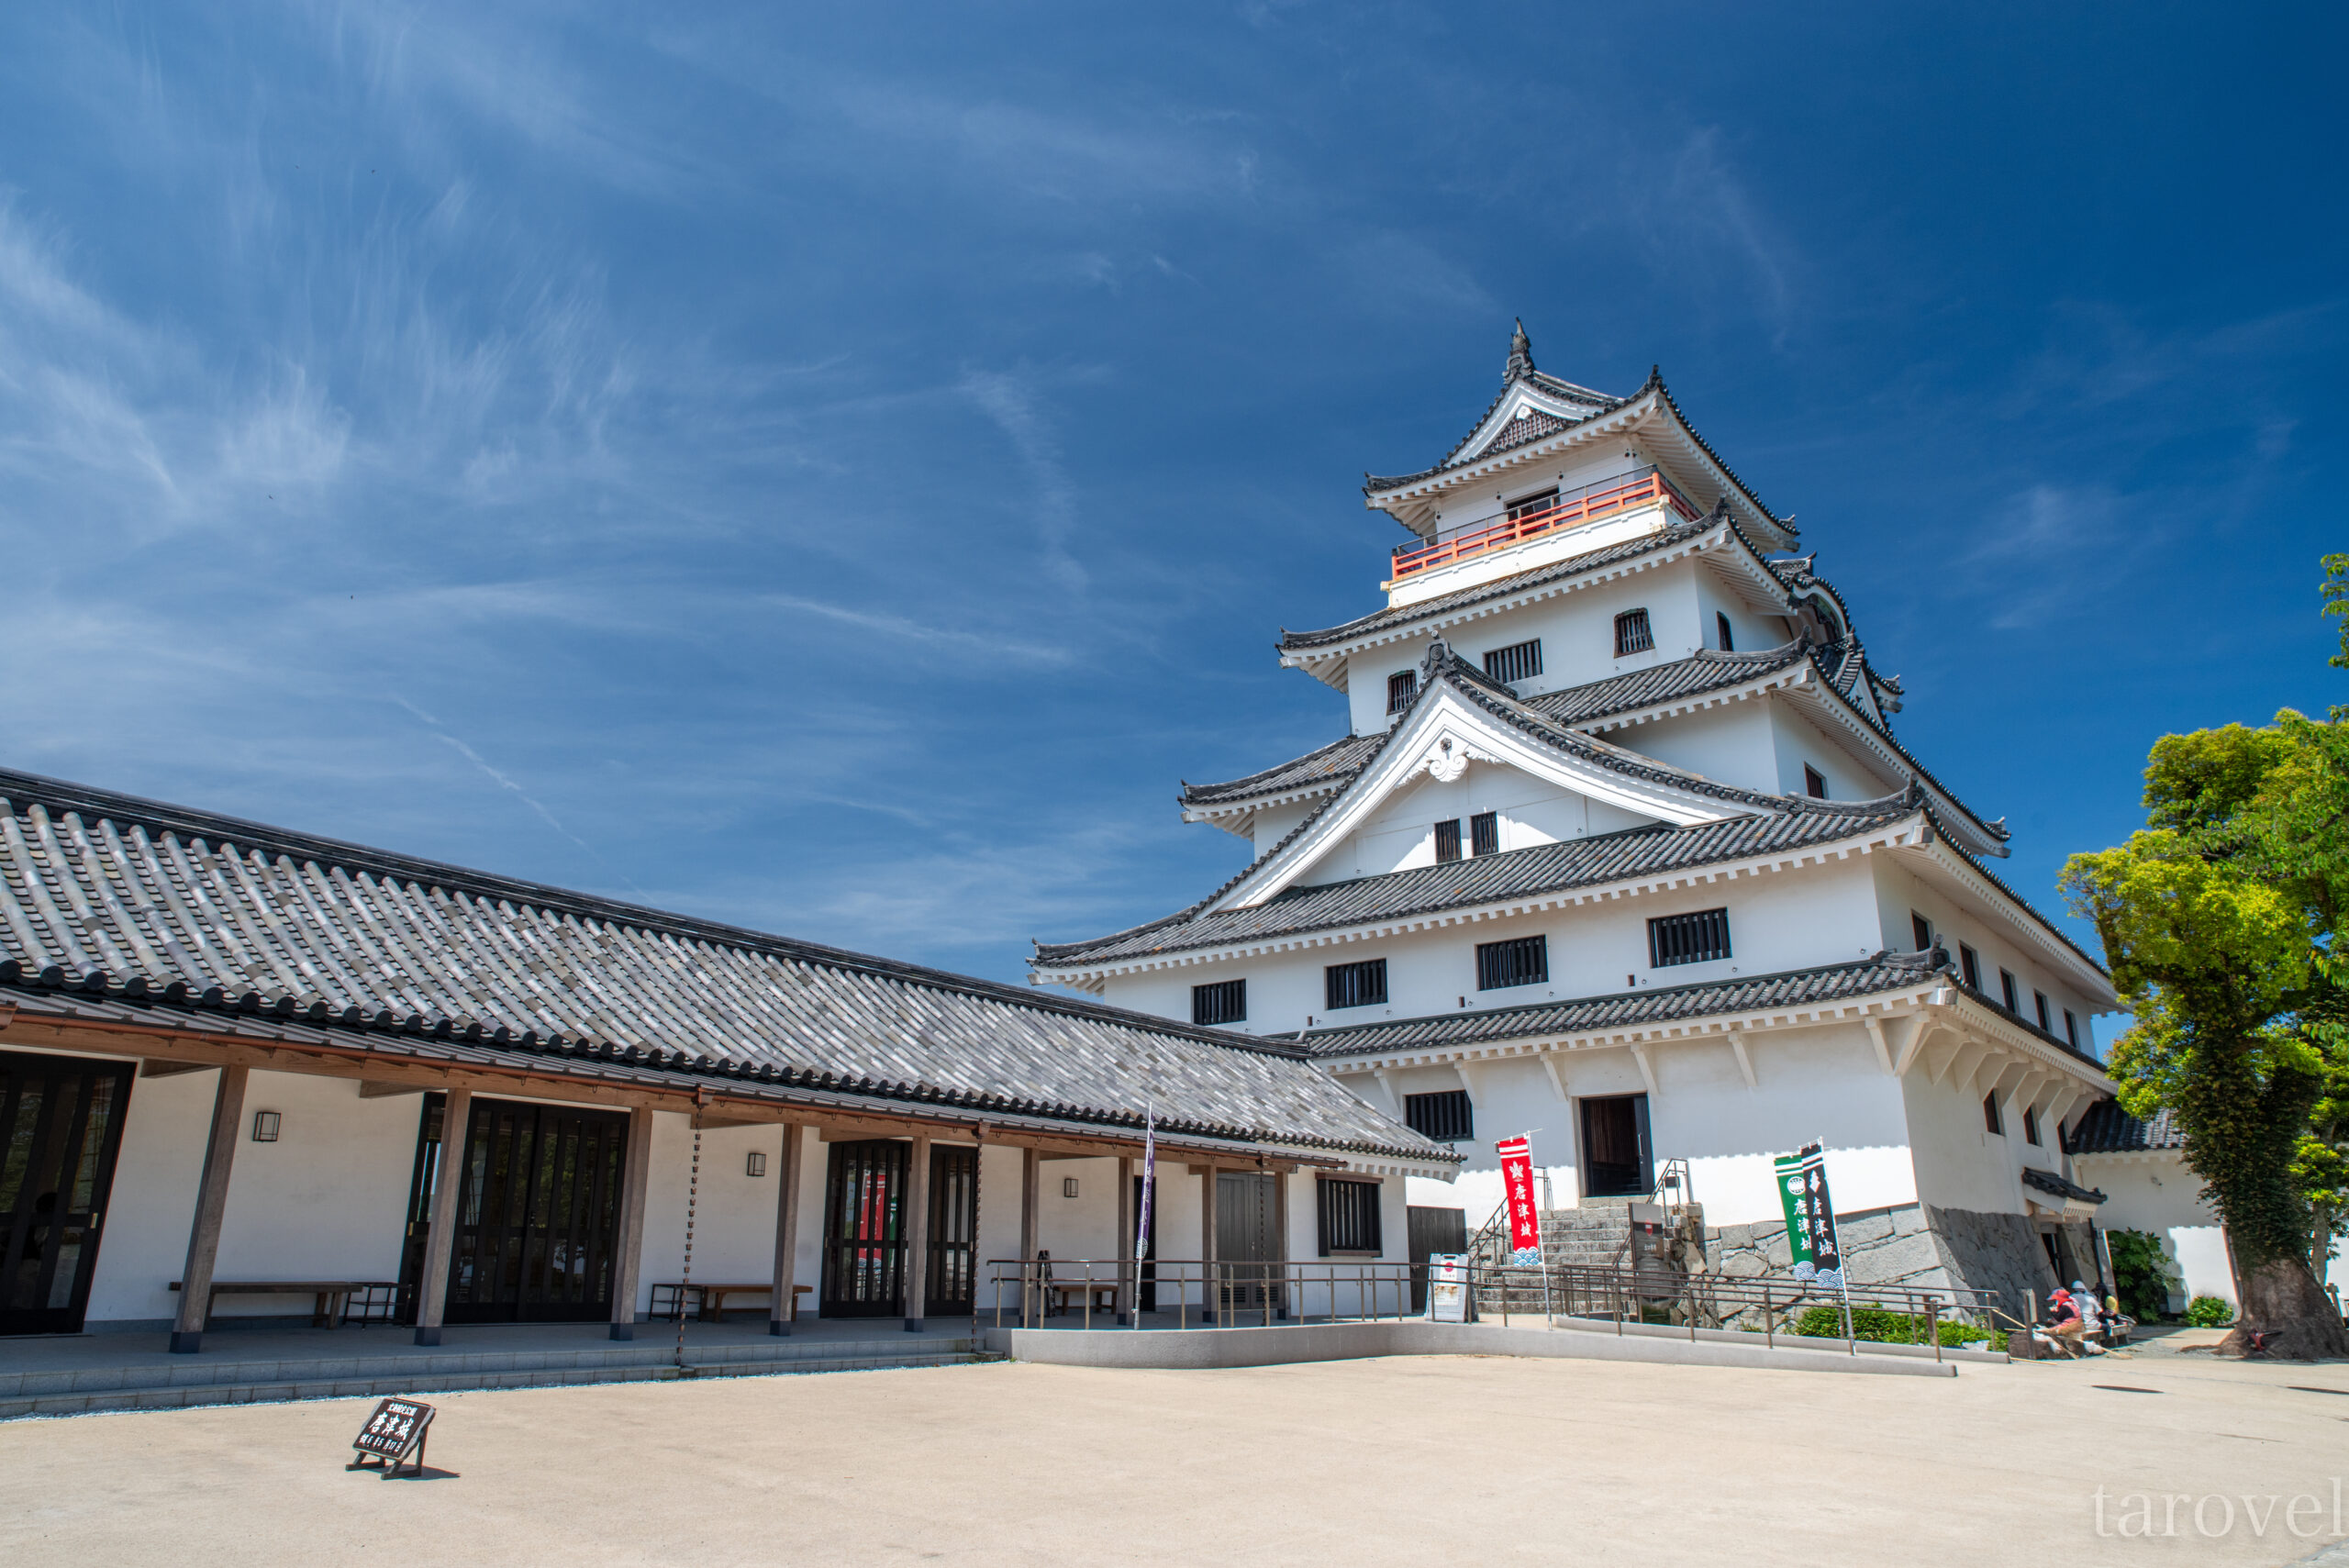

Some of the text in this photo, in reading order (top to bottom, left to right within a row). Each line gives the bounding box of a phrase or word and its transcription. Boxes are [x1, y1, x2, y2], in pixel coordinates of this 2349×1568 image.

[1514, 1183, 1531, 1237] 唐津城
[1813, 1196, 1837, 1257] 唐津城
[369, 1411, 414, 1440] 唐津城
